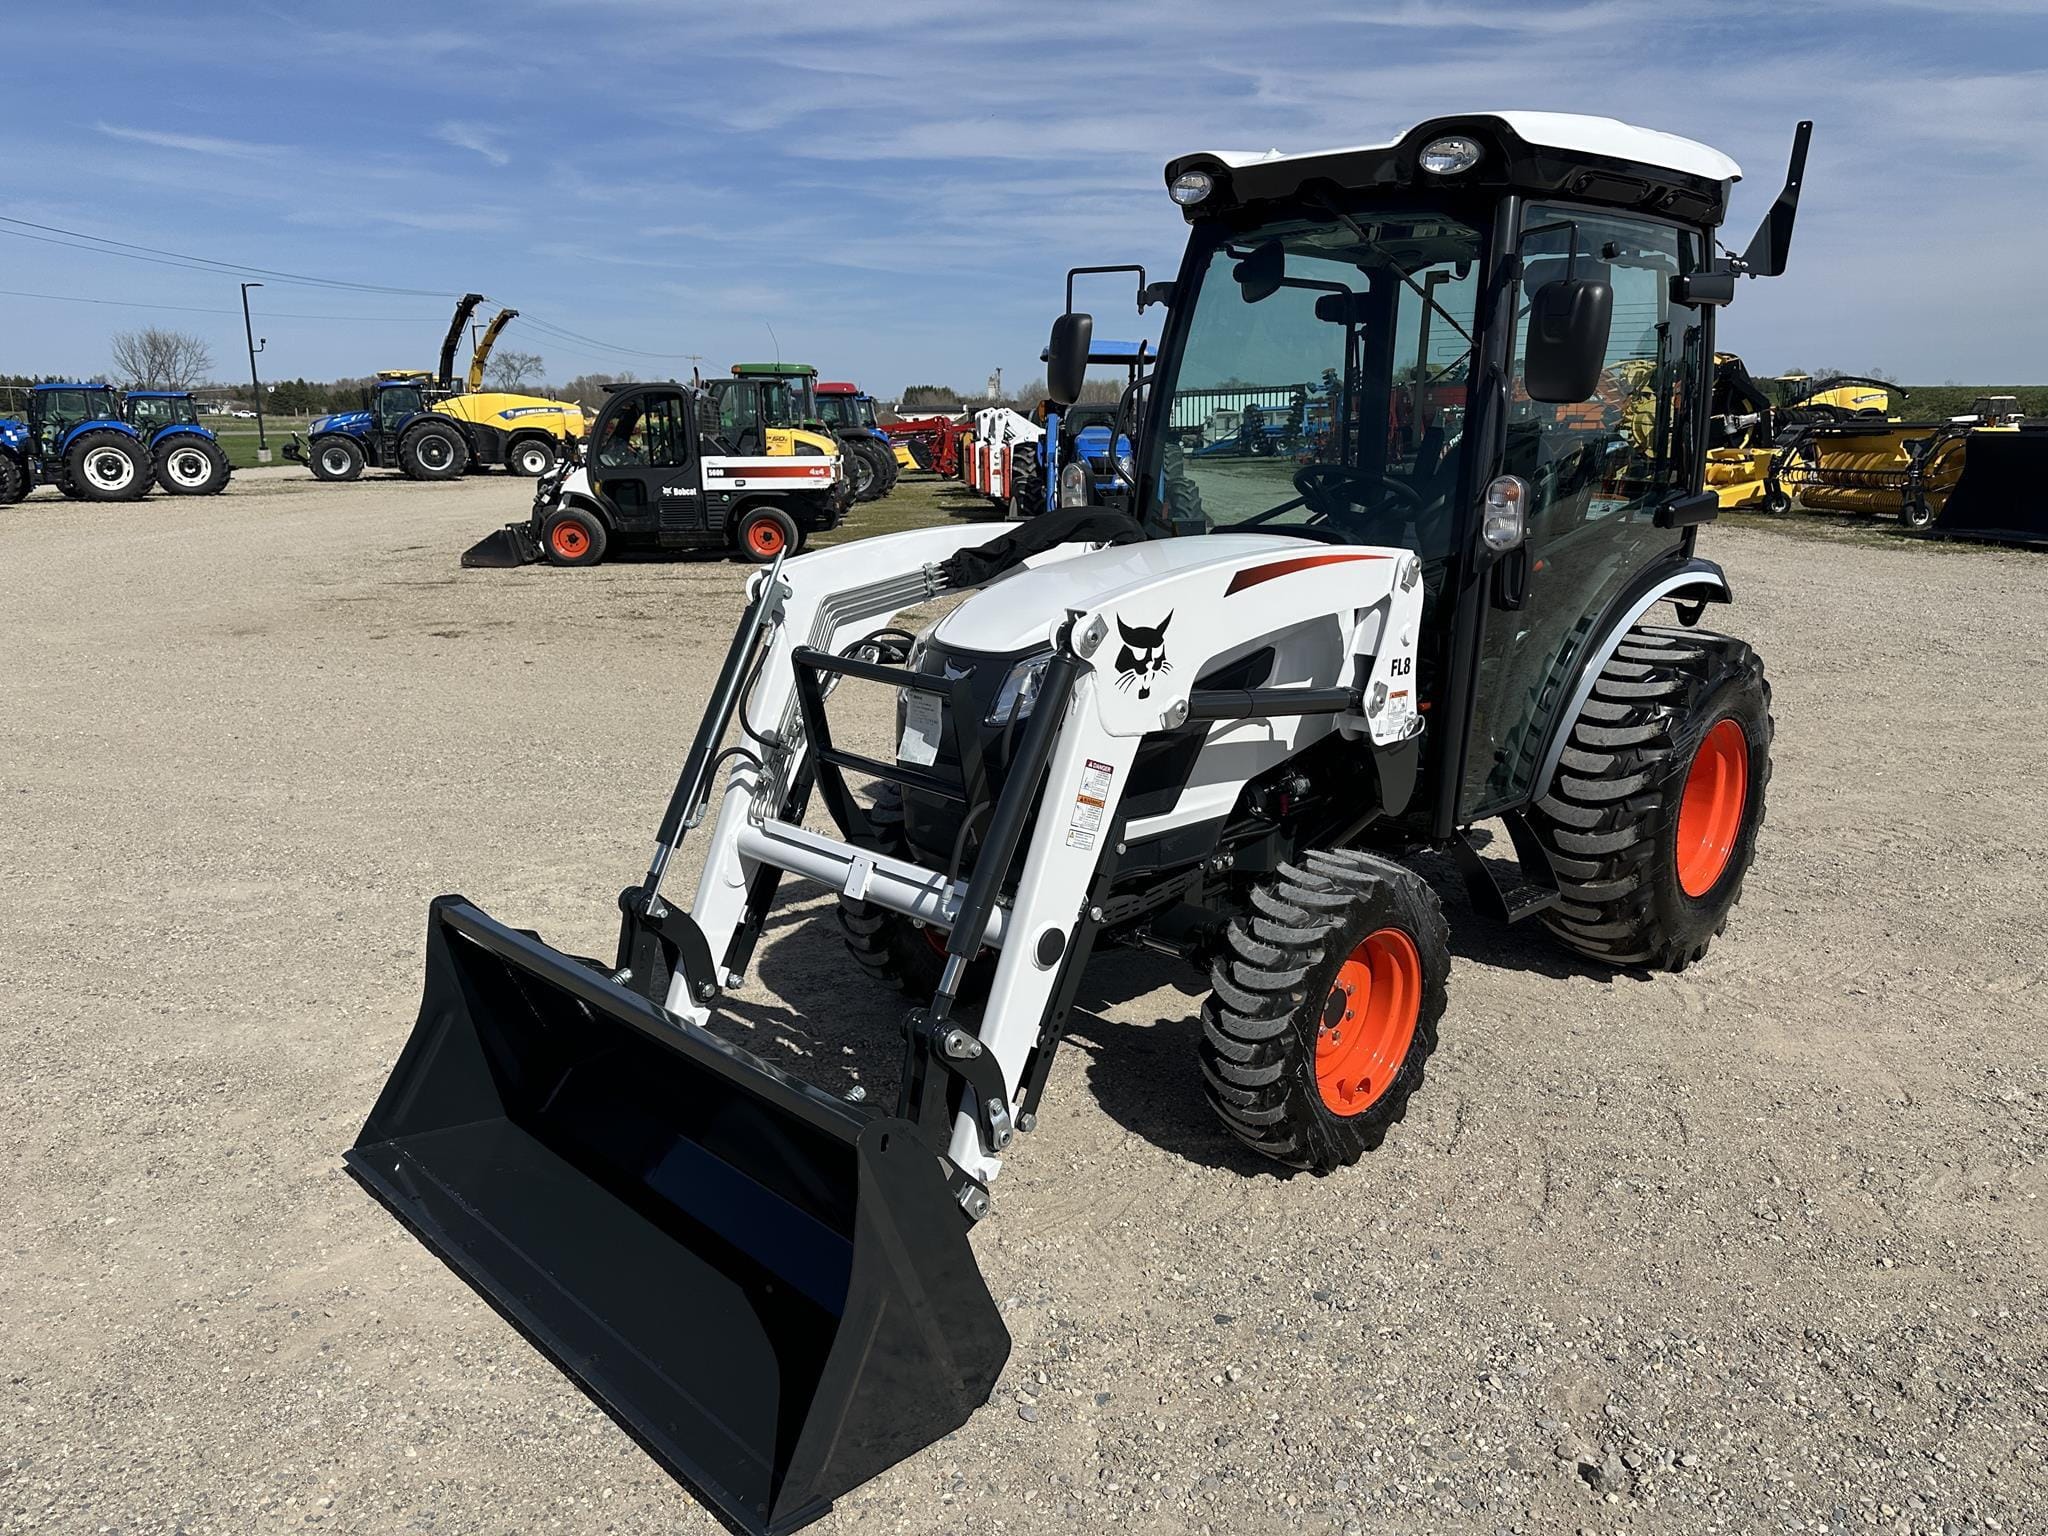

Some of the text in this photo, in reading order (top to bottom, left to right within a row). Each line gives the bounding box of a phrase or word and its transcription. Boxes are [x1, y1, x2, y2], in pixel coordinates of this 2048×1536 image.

[809, 467, 825, 476] 4x4
[673, 487, 697, 496] Bobcat
[1391, 657, 1411, 677] FL8
[1092, 762, 1112, 773] DANGER
